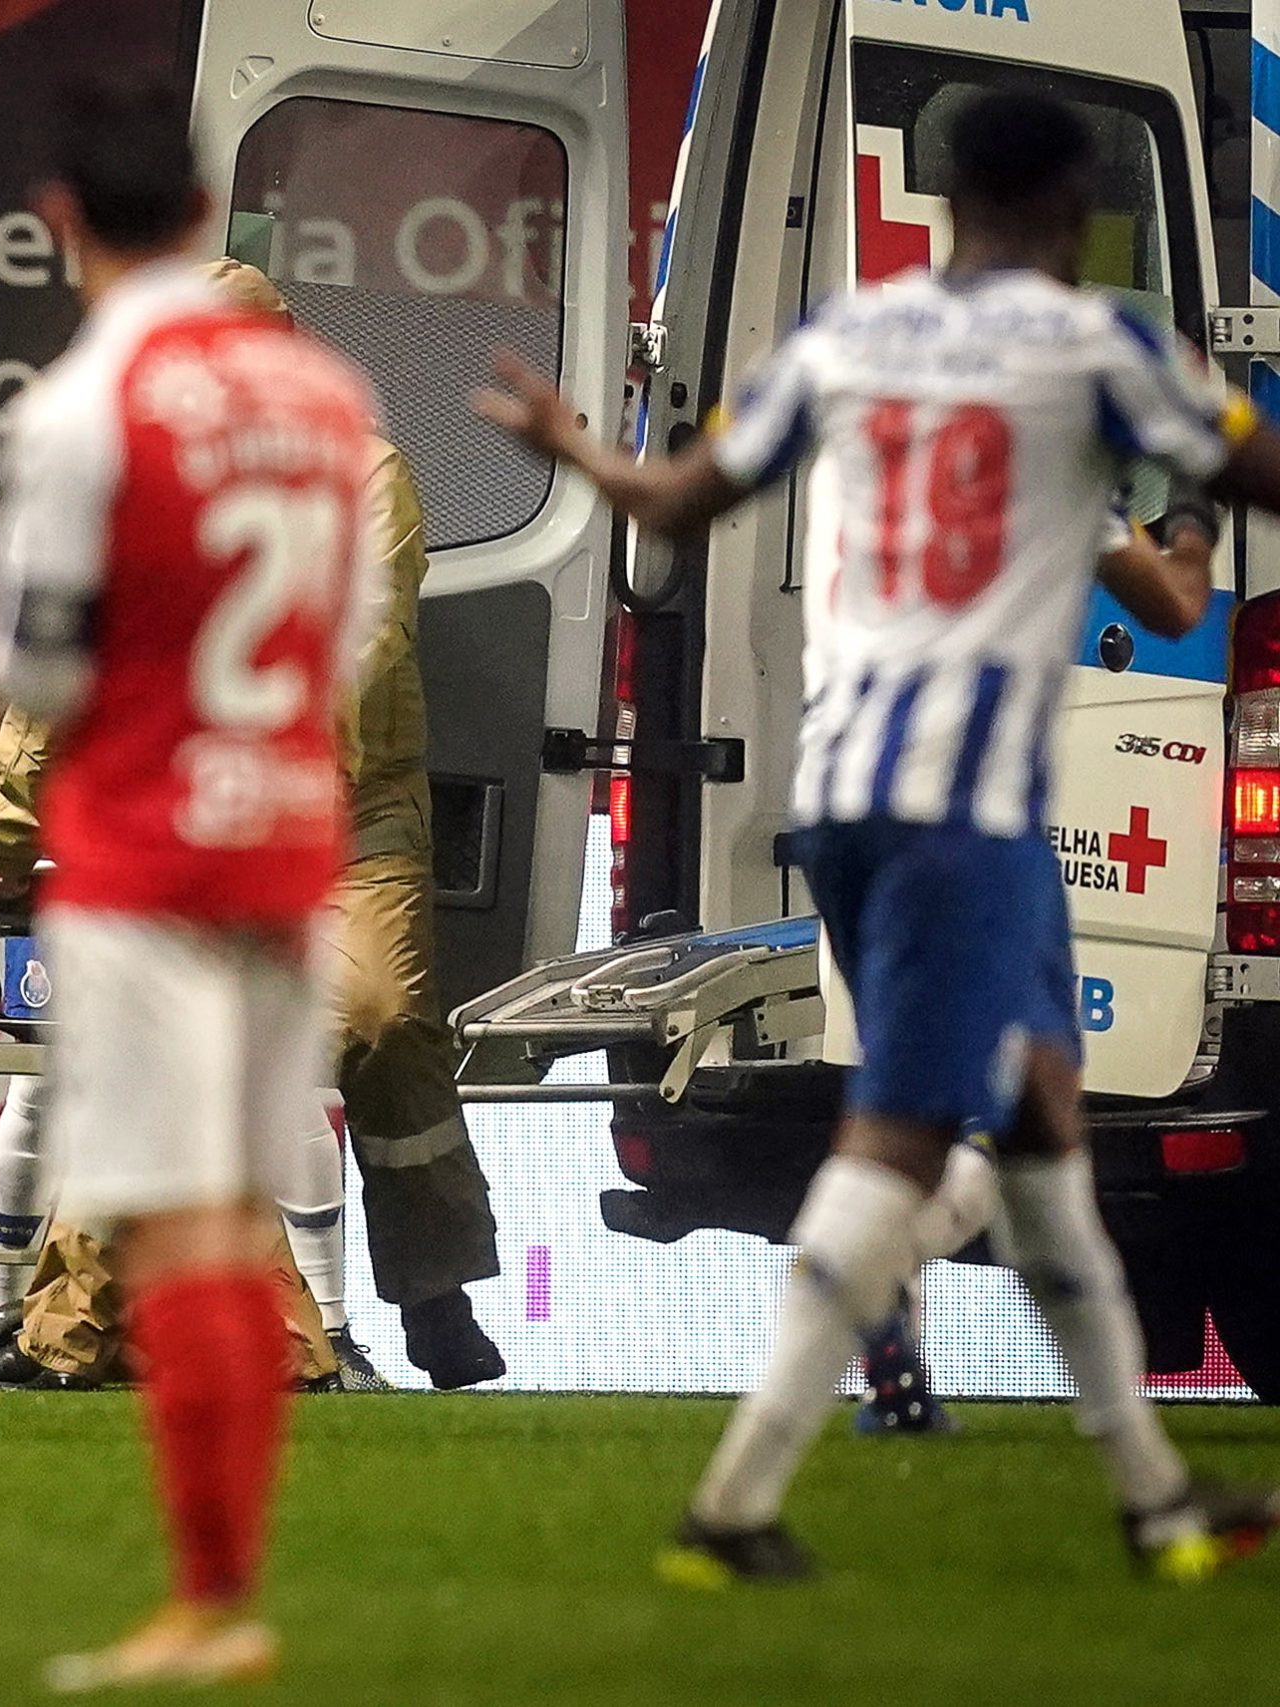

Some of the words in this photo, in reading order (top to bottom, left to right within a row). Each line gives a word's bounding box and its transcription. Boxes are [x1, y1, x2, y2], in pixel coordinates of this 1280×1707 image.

[1162, 741, 1206, 765] CDI
[1047, 826, 1101, 857] ELHA
[1064, 859, 1119, 892] UESA
[1081, 975, 1114, 1032] B
